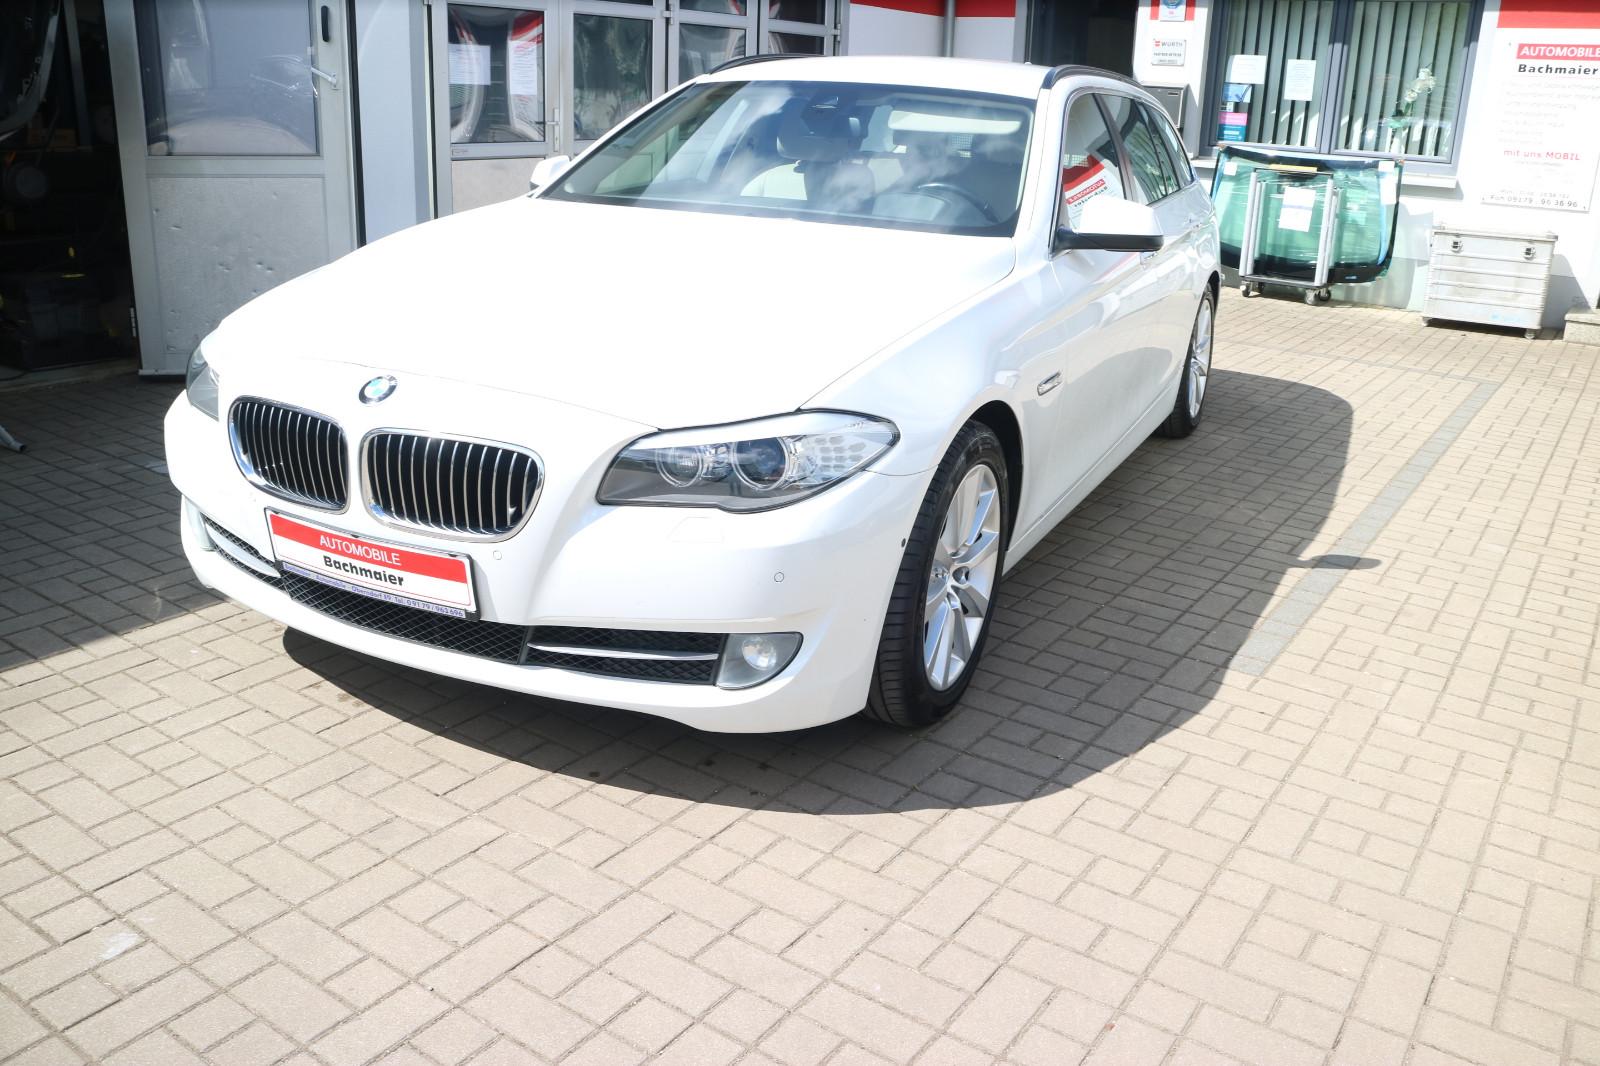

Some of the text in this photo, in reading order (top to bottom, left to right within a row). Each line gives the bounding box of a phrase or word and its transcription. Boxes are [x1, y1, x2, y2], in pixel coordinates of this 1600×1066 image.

[1520, 46, 1600, 57] AUTOMOBILE
[1518, 64, 1599, 75] Bachmaier
[1545, 152, 1581, 160] MOBIL
[319, 534, 402, 566] AUTOMOBILE
[323, 555, 404, 586] Bachmaier
